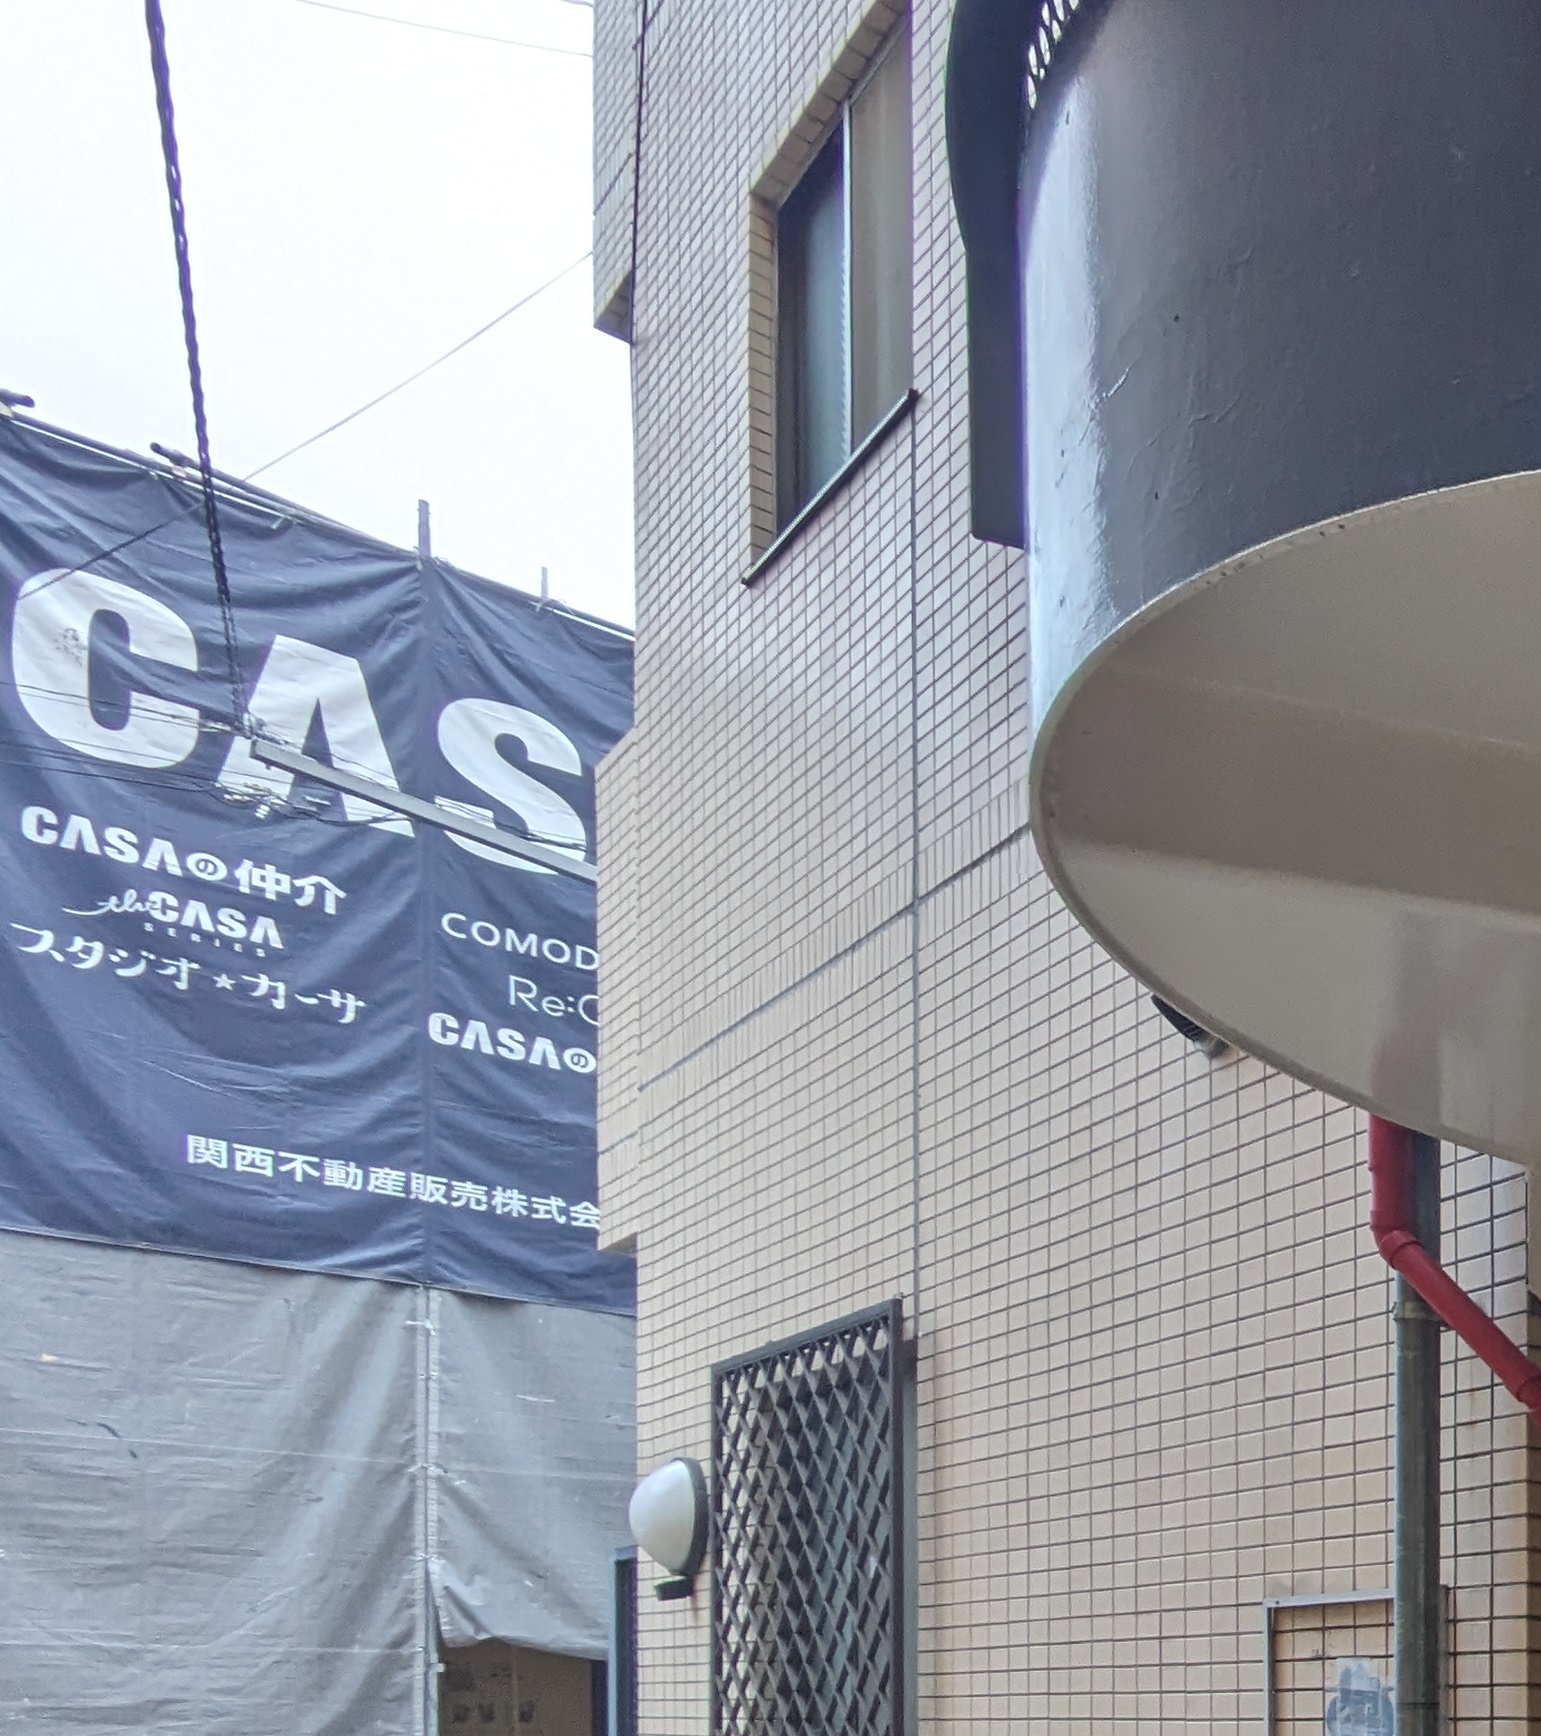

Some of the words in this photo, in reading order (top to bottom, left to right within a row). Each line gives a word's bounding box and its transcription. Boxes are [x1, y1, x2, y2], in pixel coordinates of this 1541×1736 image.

[21, 806, 347, 915] CASAの仲介
[144, 922, 266, 957] SERIES
[148, 891, 284, 949] CASA
[441, 912, 600, 970] COMOD
[428, 1012, 597, 1073] CASAの
[185, 1133, 600, 1230] 関西不動産販売株式会
